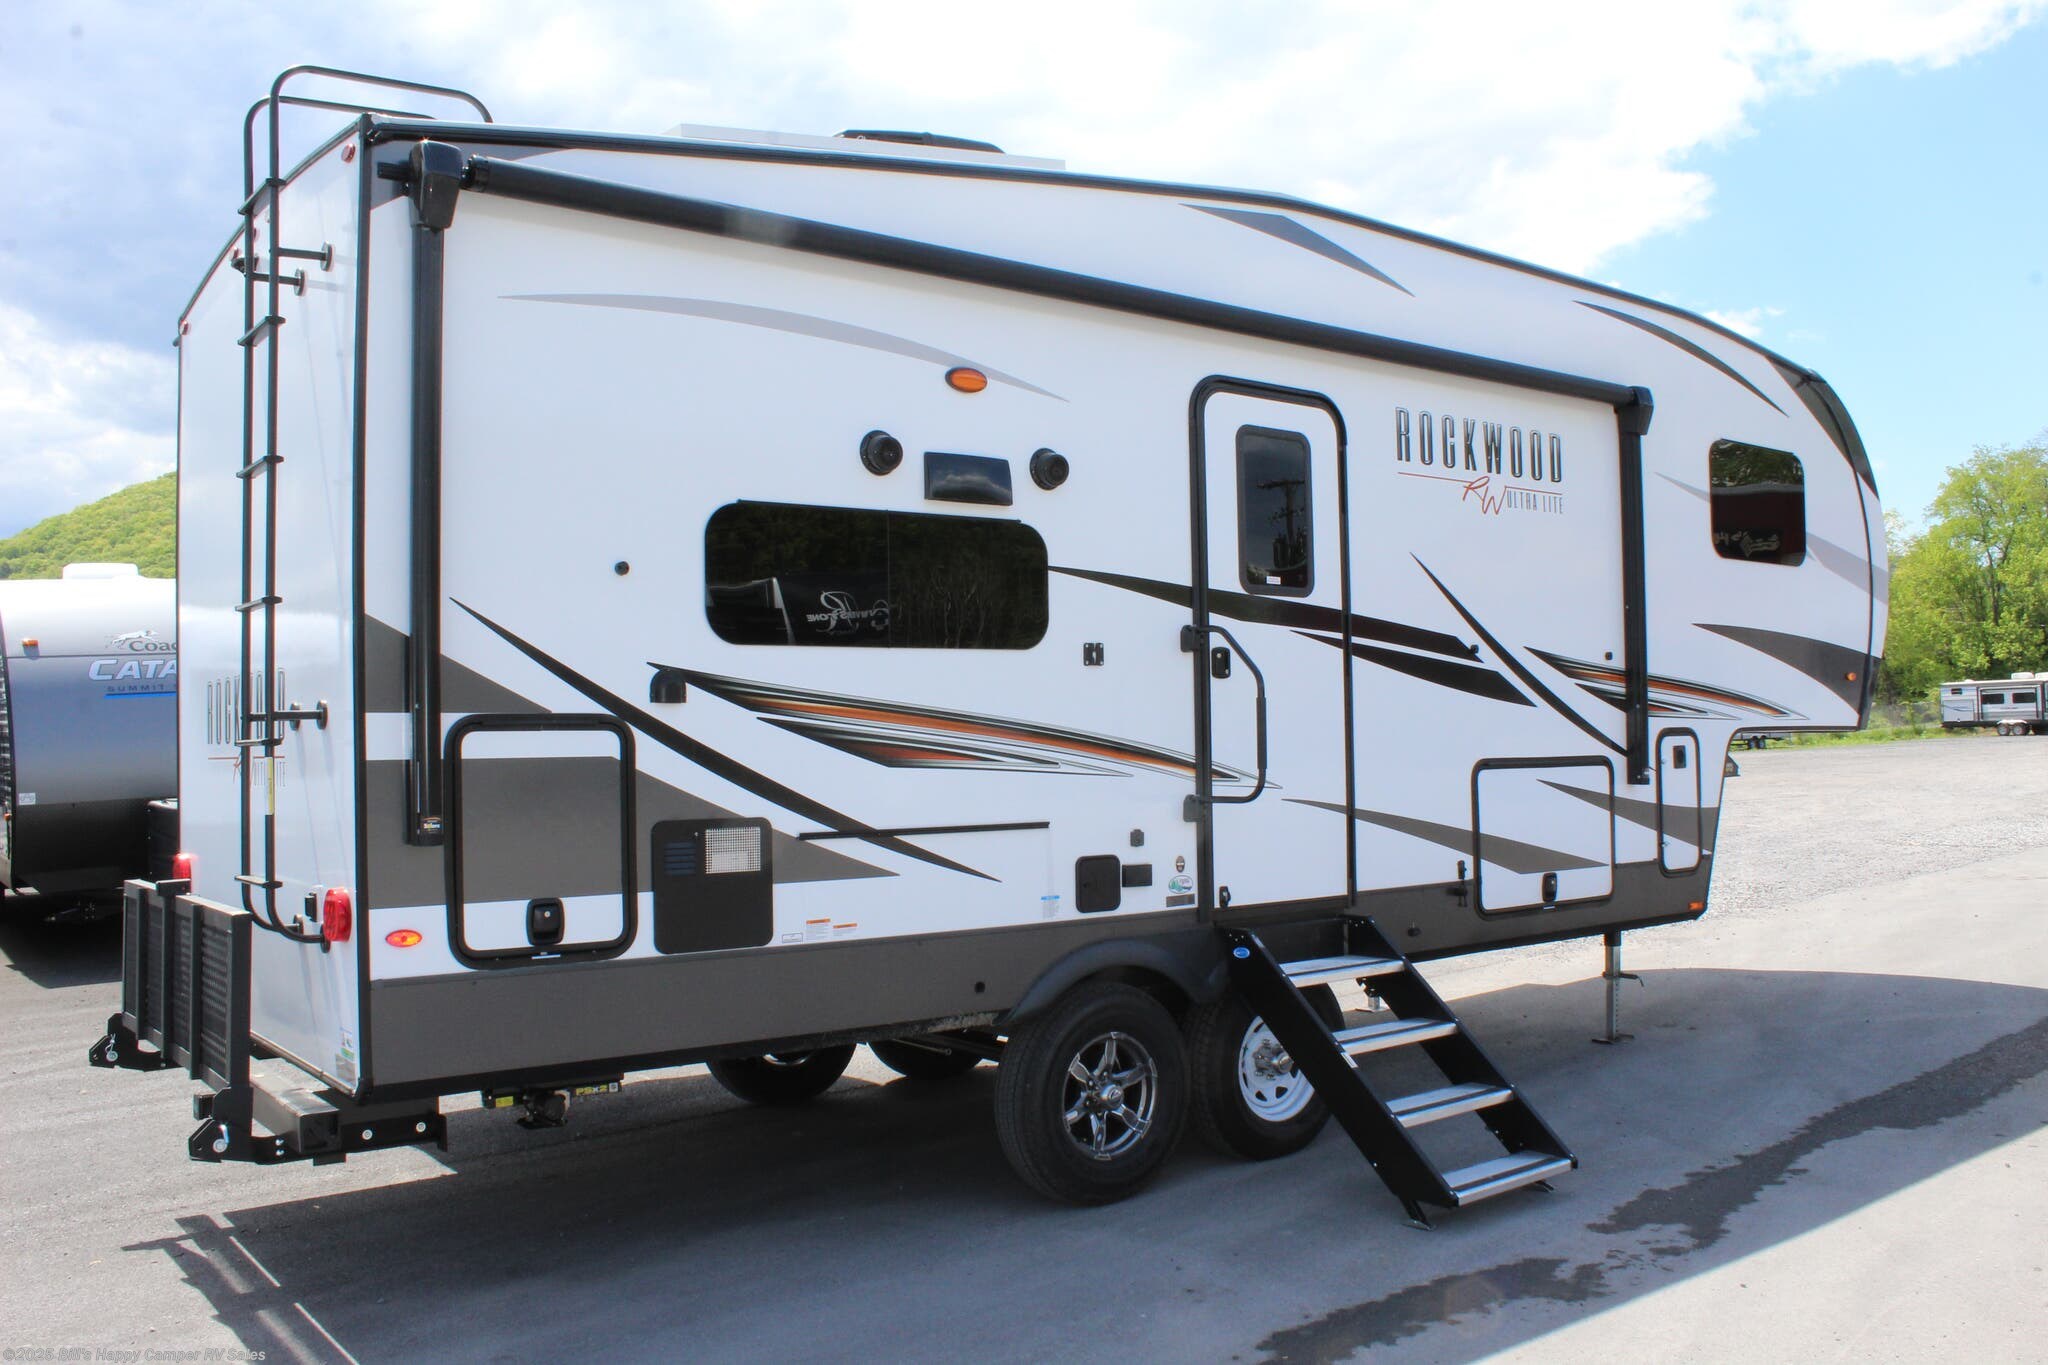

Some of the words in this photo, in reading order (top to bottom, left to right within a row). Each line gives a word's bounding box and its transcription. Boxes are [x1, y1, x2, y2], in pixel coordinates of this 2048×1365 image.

[1395, 407, 1562, 483] ROCKWOOD
[1507, 490, 1537, 511] ULTRA
[88, 659, 177, 681] CATA
[107, 684, 164, 692] SUMMIT
